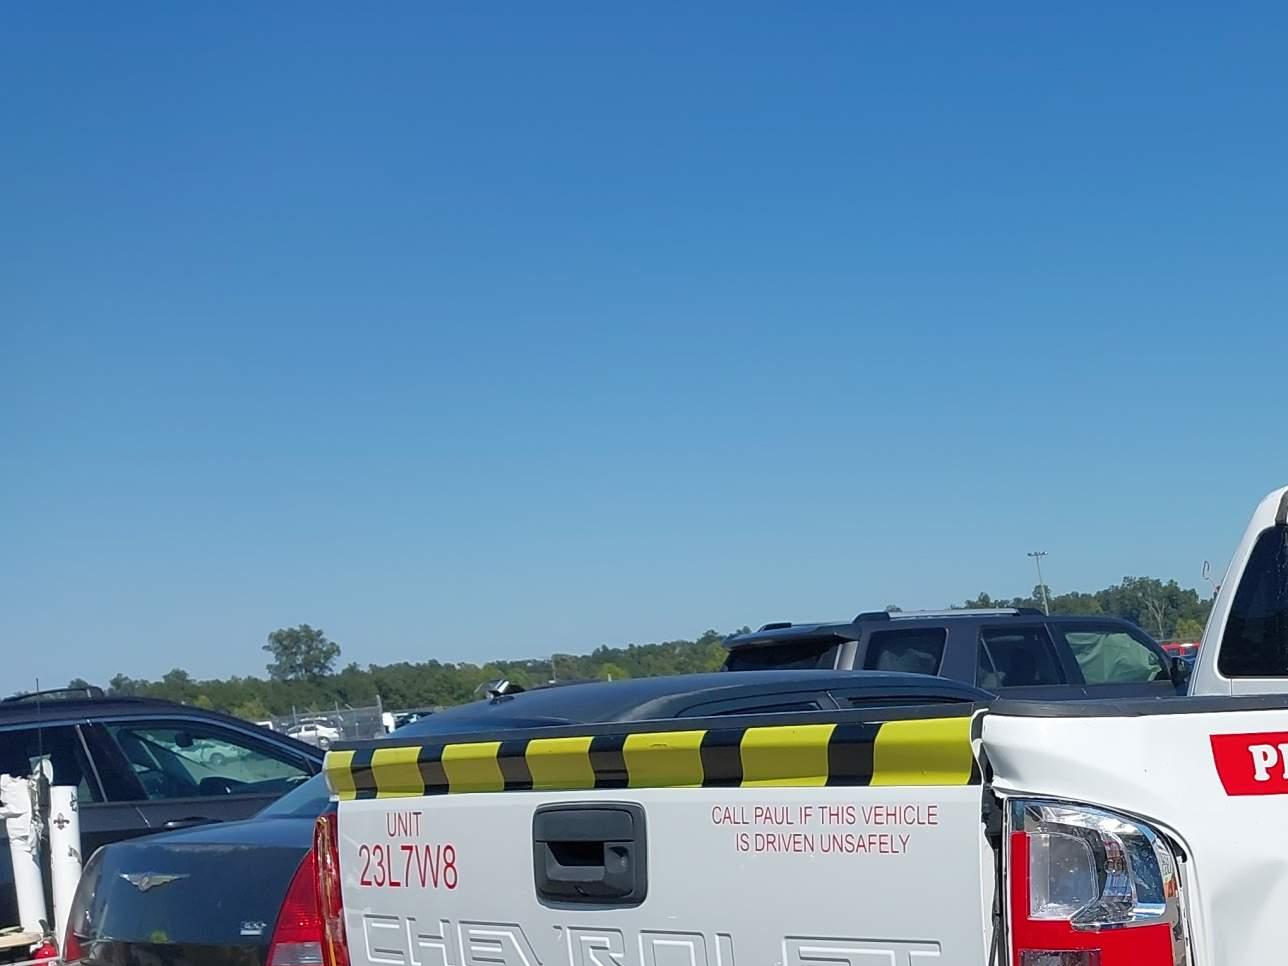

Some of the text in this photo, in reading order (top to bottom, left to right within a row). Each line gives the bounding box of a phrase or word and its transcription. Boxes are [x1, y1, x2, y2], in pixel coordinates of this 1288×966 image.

[386, 811, 422, 837] UNIT
[711, 805, 938, 825] CALL PAUL IF THIS VEHICLE
[736, 833, 910, 854] IS DRIVEN UNSAFELY
[358, 844, 458, 890] 23L7W8
